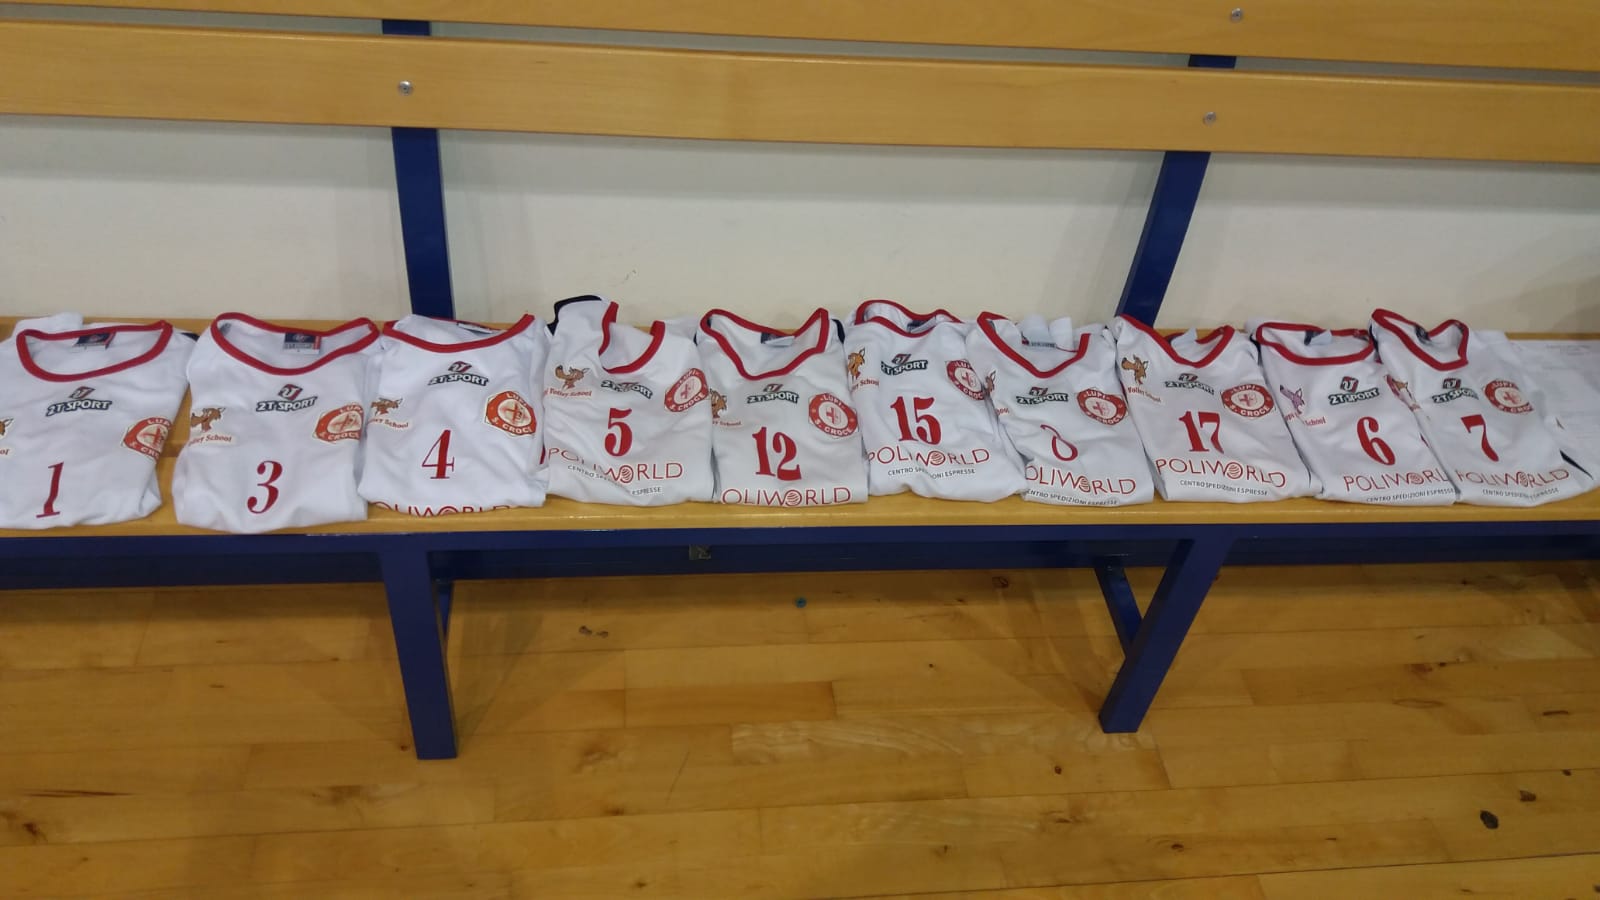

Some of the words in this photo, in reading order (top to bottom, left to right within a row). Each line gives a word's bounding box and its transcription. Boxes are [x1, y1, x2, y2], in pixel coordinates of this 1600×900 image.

[893, 360, 928, 374] SPORT
[448, 373, 489, 386] SPORT
[678, 392, 706, 411] CROCE
[763, 391, 799, 404] SPORT
[824, 394, 843, 406] LUPI
[963, 388, 983, 399] CROC
[1032, 392, 1068, 404] SPORT
[1087, 390, 1107, 400] LUPI
[1328, 393, 1345, 405] 2T
[1345, 387, 1380, 402] SPORT
[1432, 393, 1449, 403] 2T
[46, 403, 65, 416] 2T
[66, 399, 112, 413] SPORT
[256, 401, 274, 412] 2T
[275, 396, 318, 412] SPORT
[1241, 406, 1270, 417] CROCE
[491, 416, 500, 425] S.
[890, 396, 942, 445] 15
[206, 434, 232, 442] School
[605, 408, 633, 457] 5
[824, 427, 852, 437] CROCE
[1178, 411, 1224, 454] 17
[1460, 414, 1500, 463] 7
[1356, 416, 1396, 466] 6
[421, 429, 455, 479] 4
[752, 426, 802, 482] 12
[888, 467, 914, 476] CENTRO
[945, 468, 975, 477] ESPRESSE
[1025, 465, 1137, 495] OLIWORLD
[1155, 458, 1286, 488] POLIWORLD
[1343, 468, 1450, 492] POLIWORL
[36, 461, 64, 518] 1
[247, 460, 283, 514] 3
[1027, 489, 1049, 499] ENTRO
[1180, 480, 1205, 488] CENTRO
[1237, 487, 1268, 496] ESPRESSE
[1392, 490, 1426, 500] SPEDIZIONI
[722, 487, 852, 507] OLIWORLD
